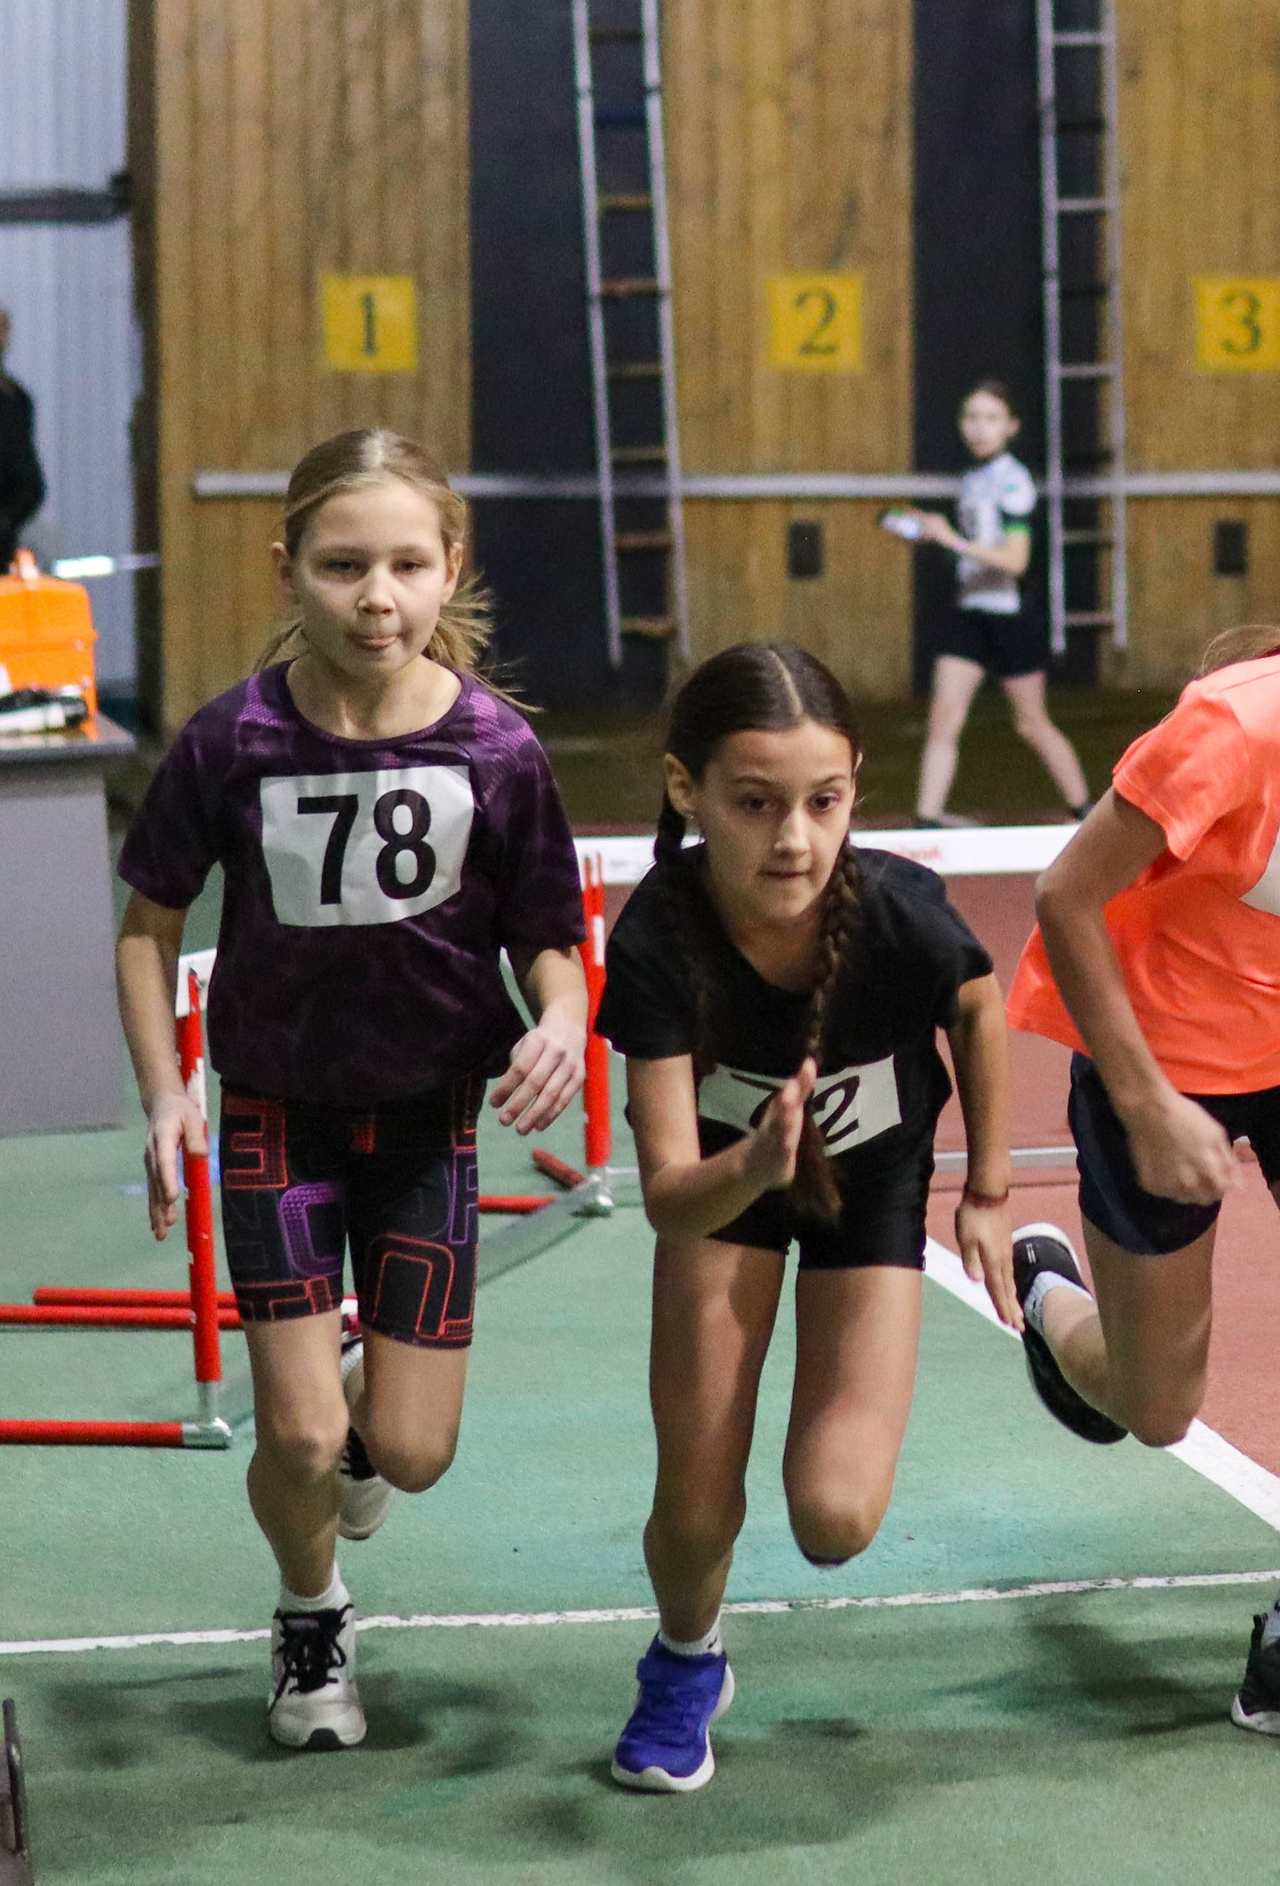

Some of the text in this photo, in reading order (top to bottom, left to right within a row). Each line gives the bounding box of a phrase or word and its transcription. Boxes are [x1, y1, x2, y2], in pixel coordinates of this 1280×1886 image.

[357, 291, 381, 359] 1
[793, 287, 841, 359] 2
[1220, 290, 1265, 358] 3
[296, 789, 437, 905] 78
